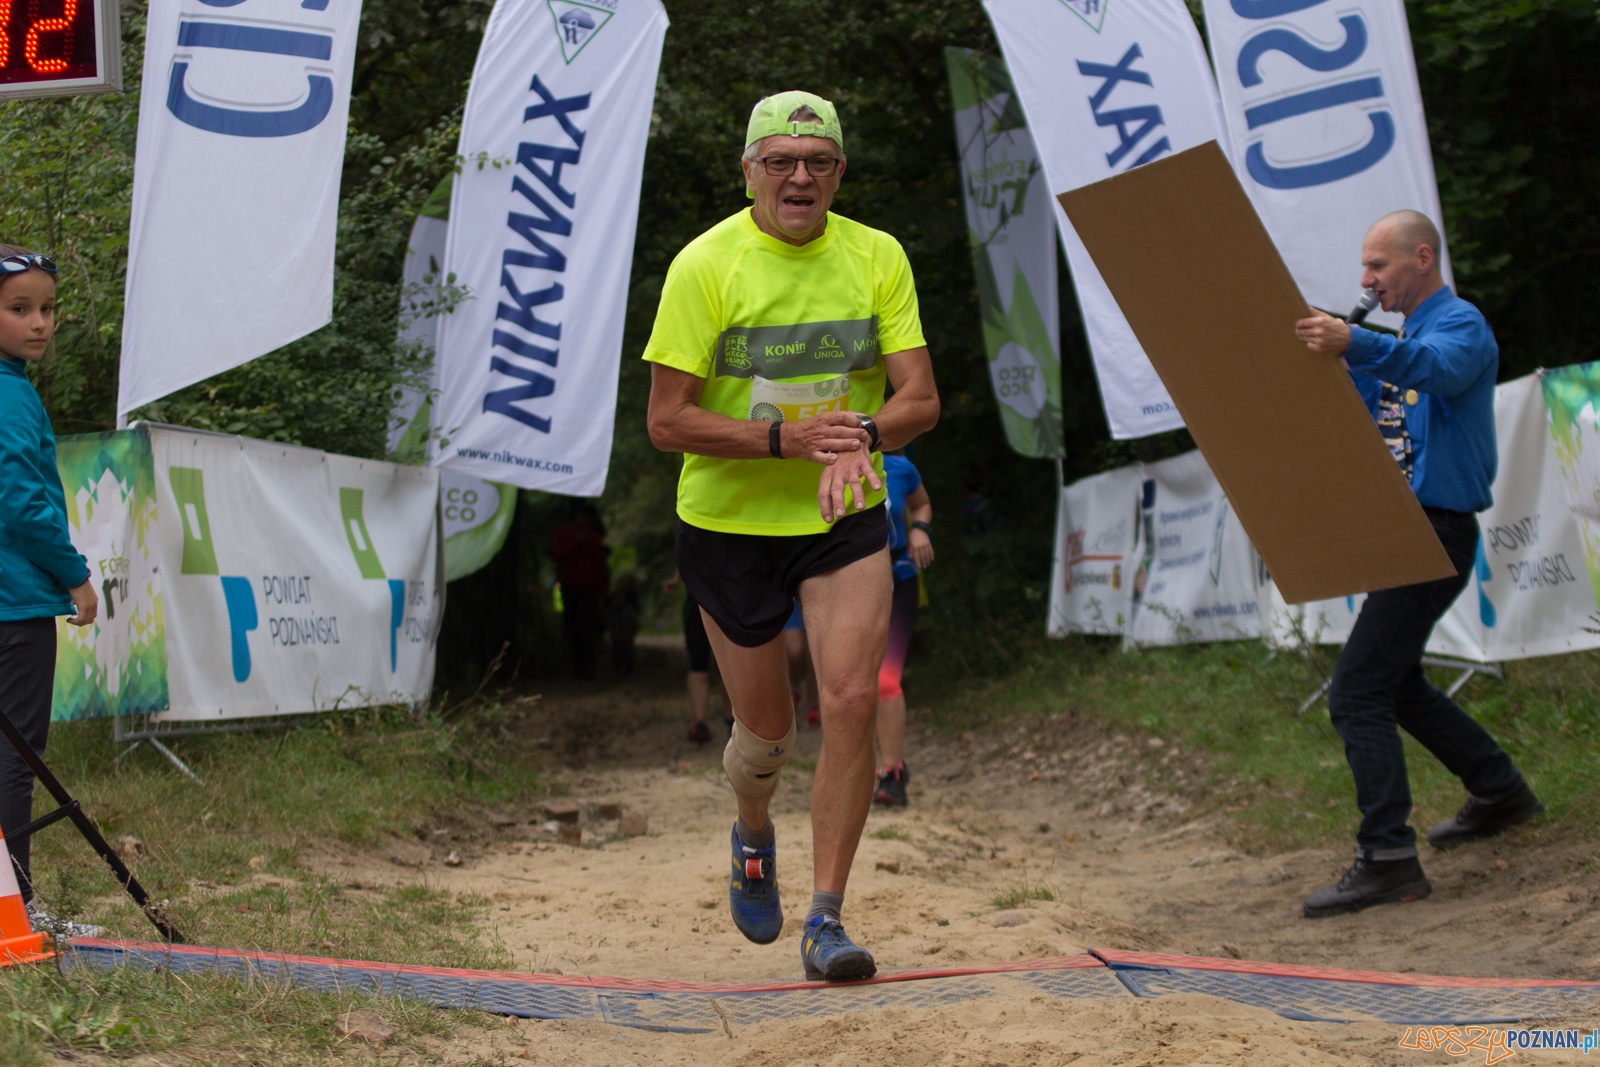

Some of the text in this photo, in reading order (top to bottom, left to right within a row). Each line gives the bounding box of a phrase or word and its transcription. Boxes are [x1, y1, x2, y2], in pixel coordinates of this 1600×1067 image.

[482, 74, 592, 433] NIKWAX
[814, 350, 845, 360] UNIQA
[456, 447, 574, 475] www.nikwax.com
[262, 575, 312, 604] POWIAT
[269, 610, 340, 647] POZNAŃSKI
